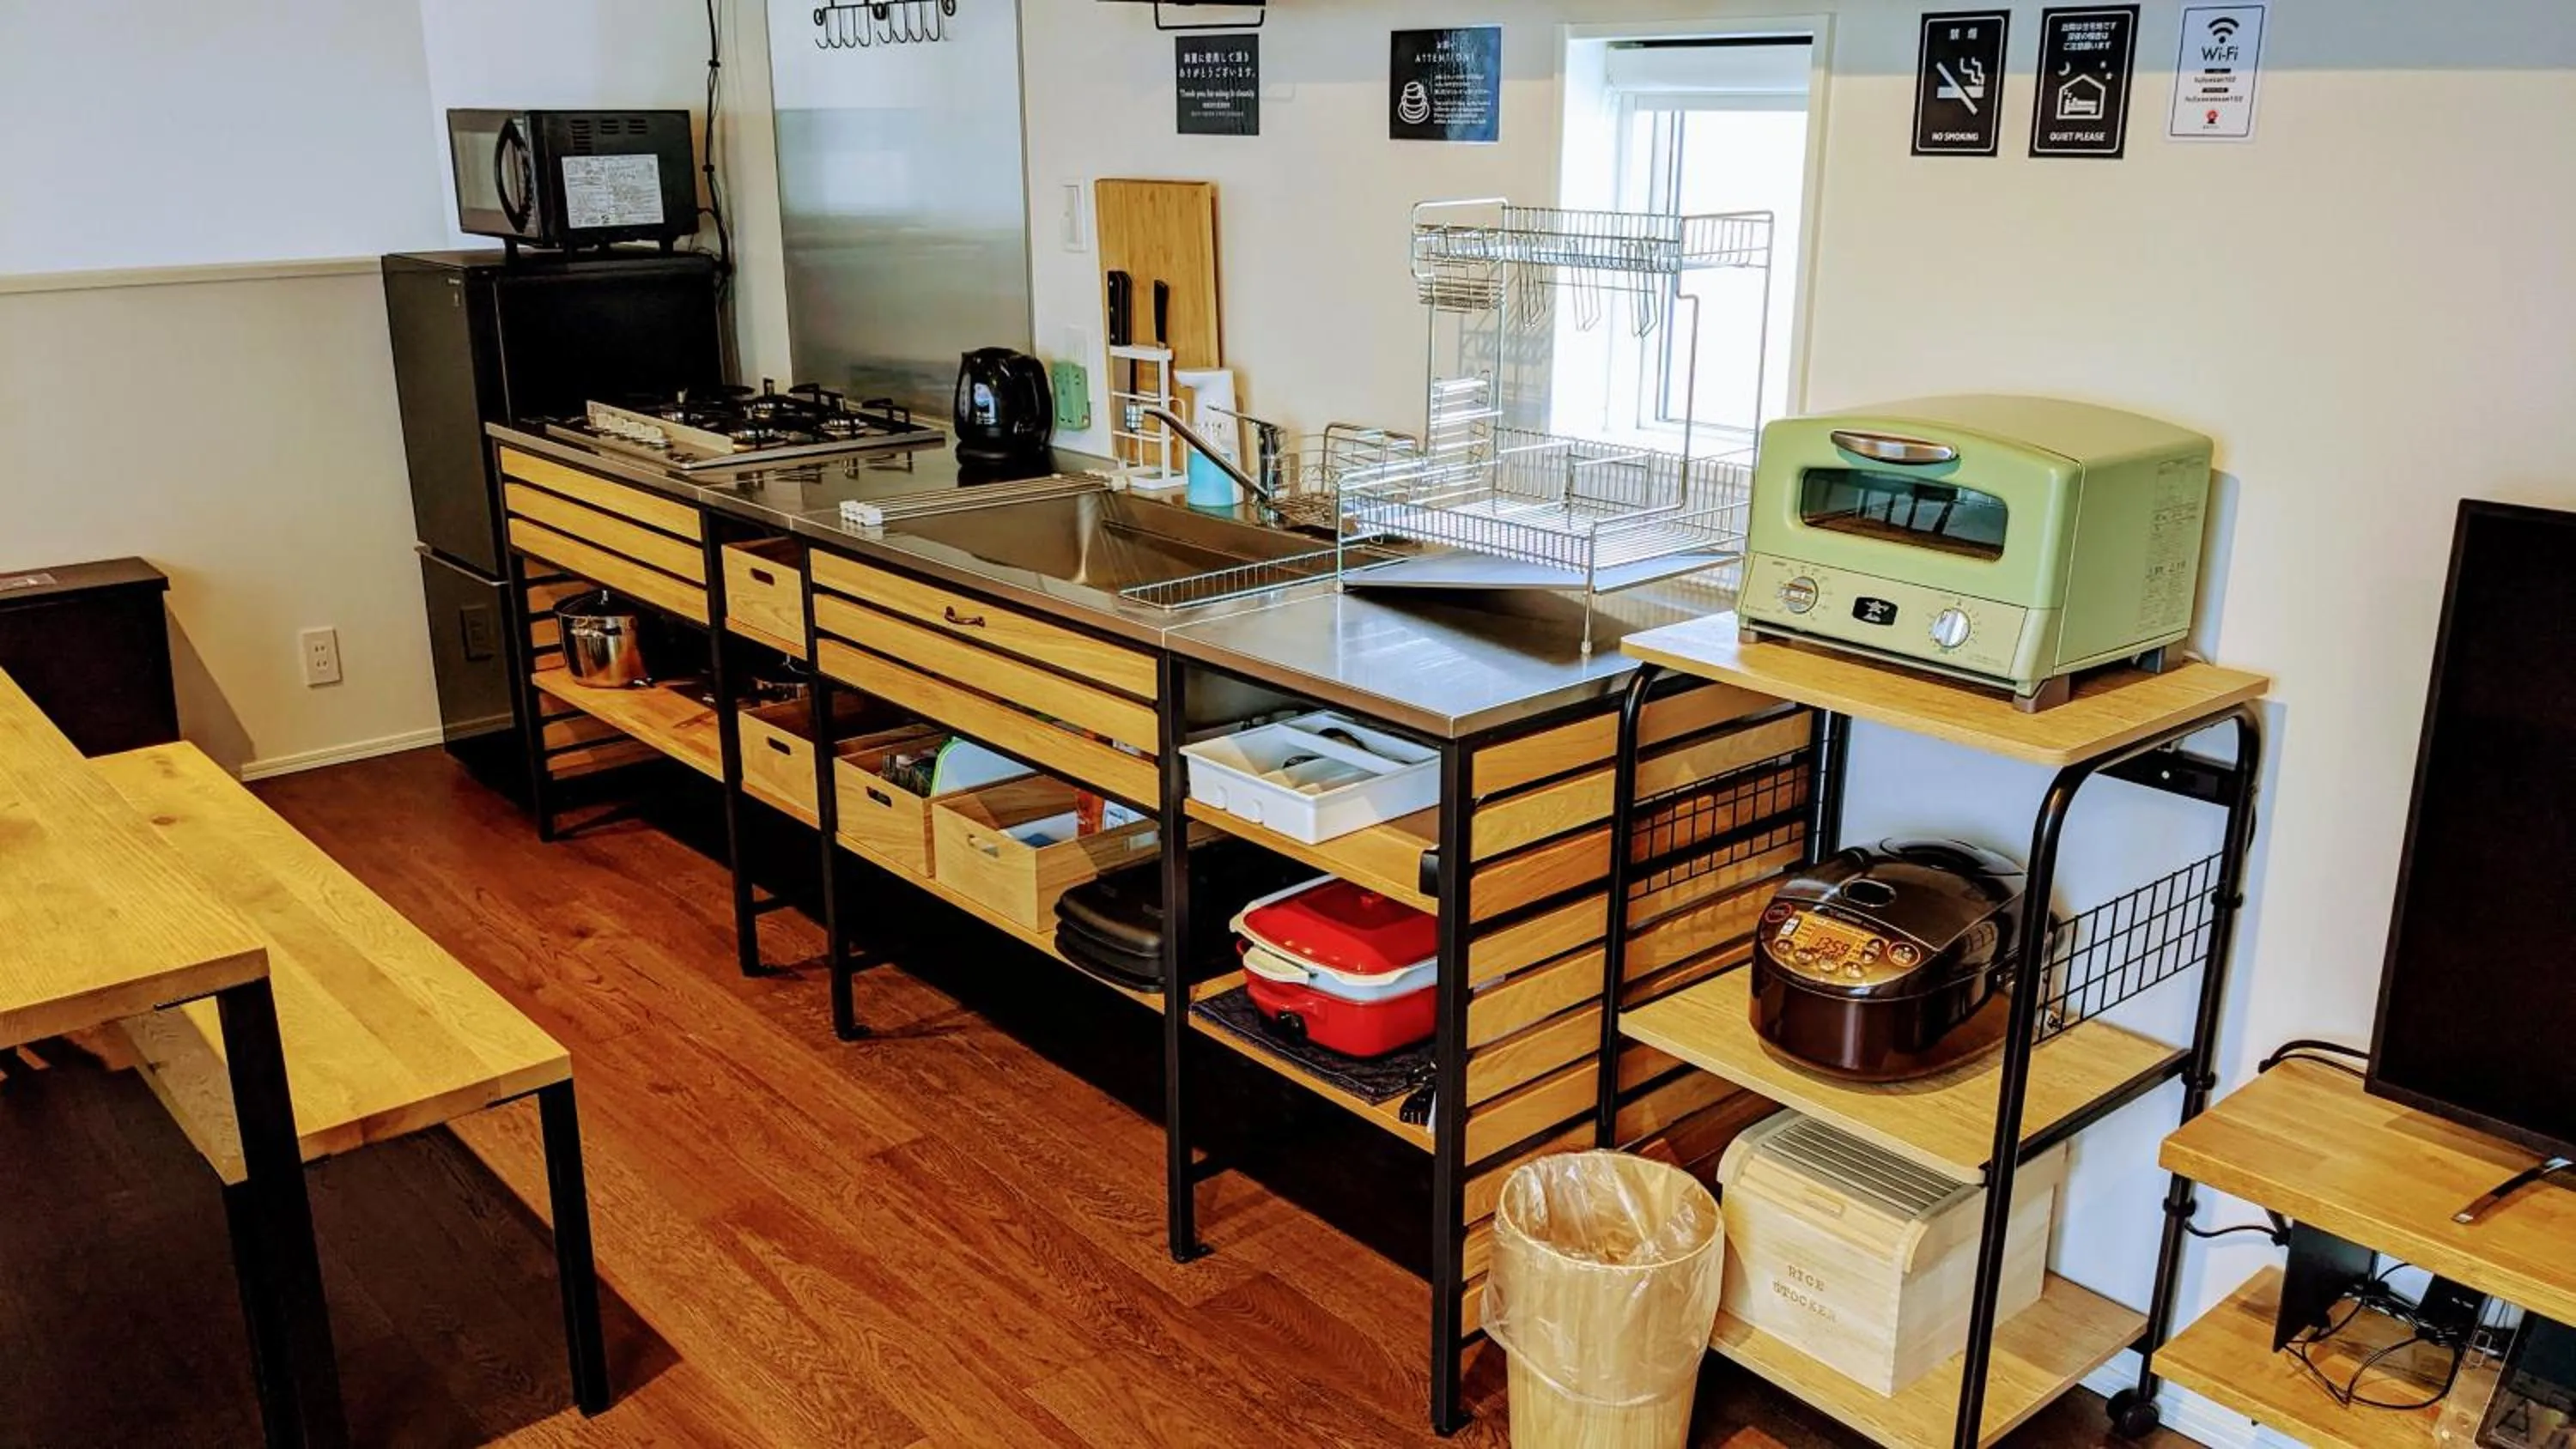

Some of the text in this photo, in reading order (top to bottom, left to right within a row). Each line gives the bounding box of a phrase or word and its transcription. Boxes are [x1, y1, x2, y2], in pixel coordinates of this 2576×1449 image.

[2201, 46, 2239, 61] Wi-Fi
[1932, 132, 1979, 142] NO SMOKING
[2049, 131, 2105, 142] QUIET PLEASE
[1788, 1264, 1825, 1291] RICE
[1772, 1280, 1838, 1323] STOCKER
